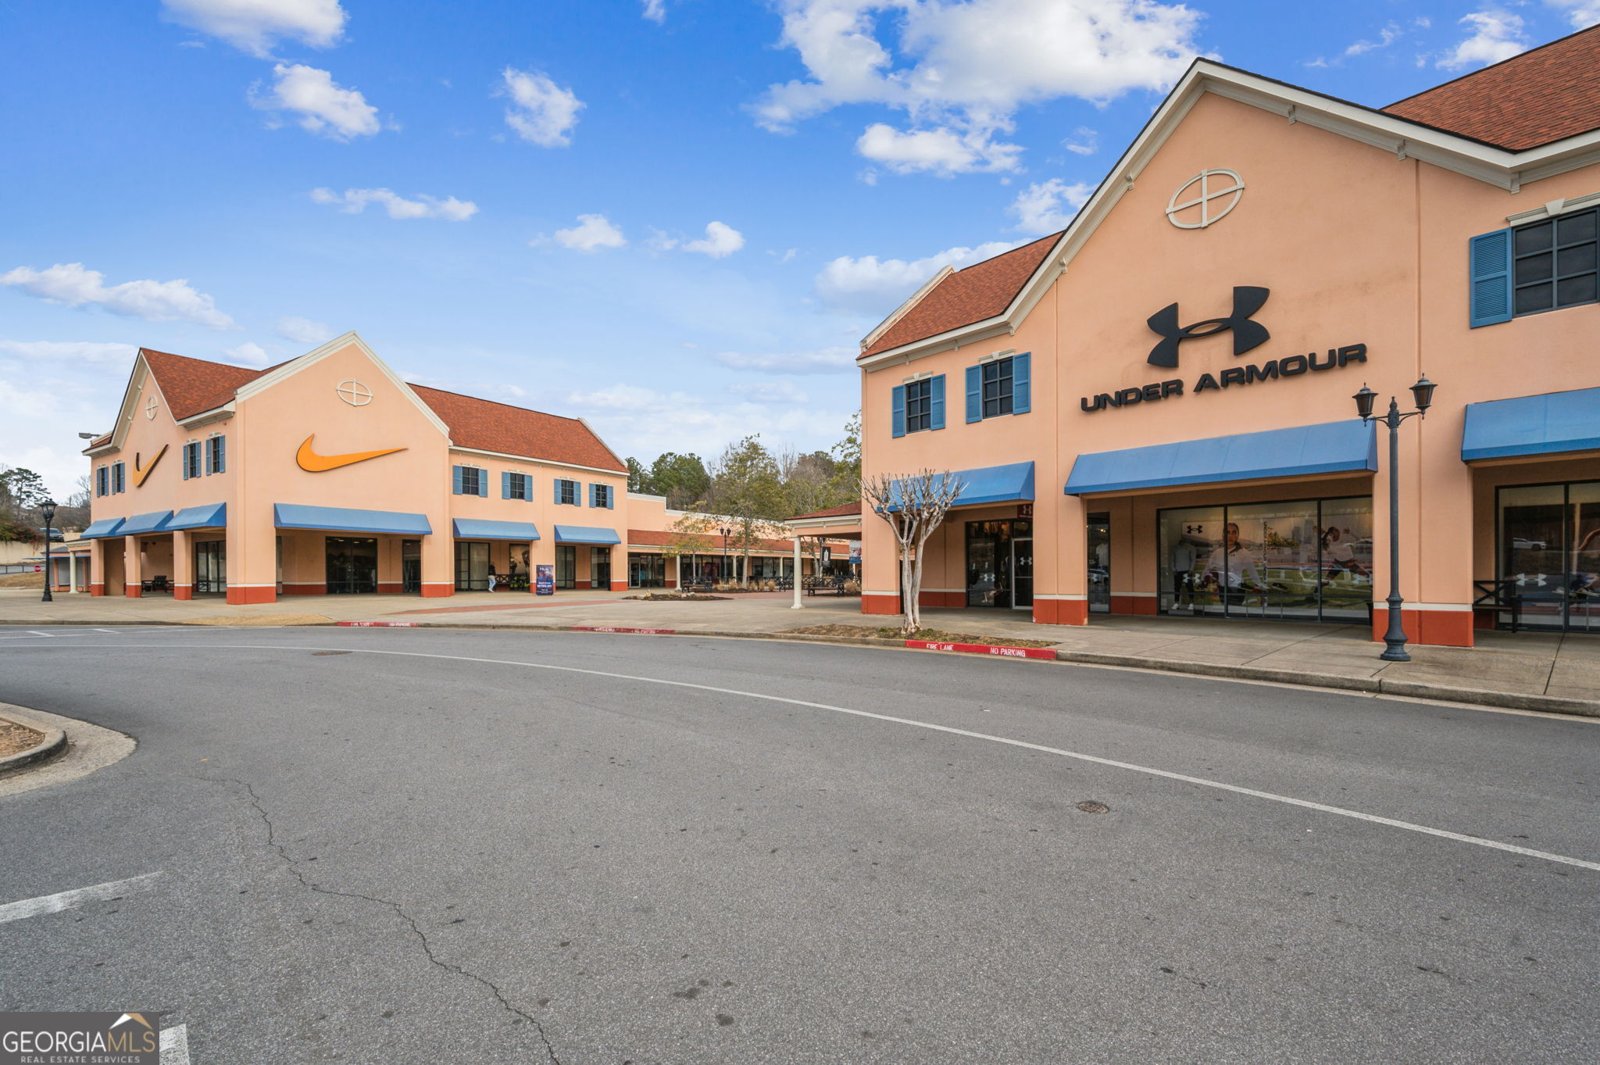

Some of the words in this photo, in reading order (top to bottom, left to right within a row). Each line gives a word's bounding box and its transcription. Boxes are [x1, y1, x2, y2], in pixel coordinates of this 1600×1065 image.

[1080, 378, 1185, 413] UNDER
[1192, 343, 1368, 393] ARMOUR
[990, 646, 999, 655] NO
[1000, 647, 1026, 658] PARKING
